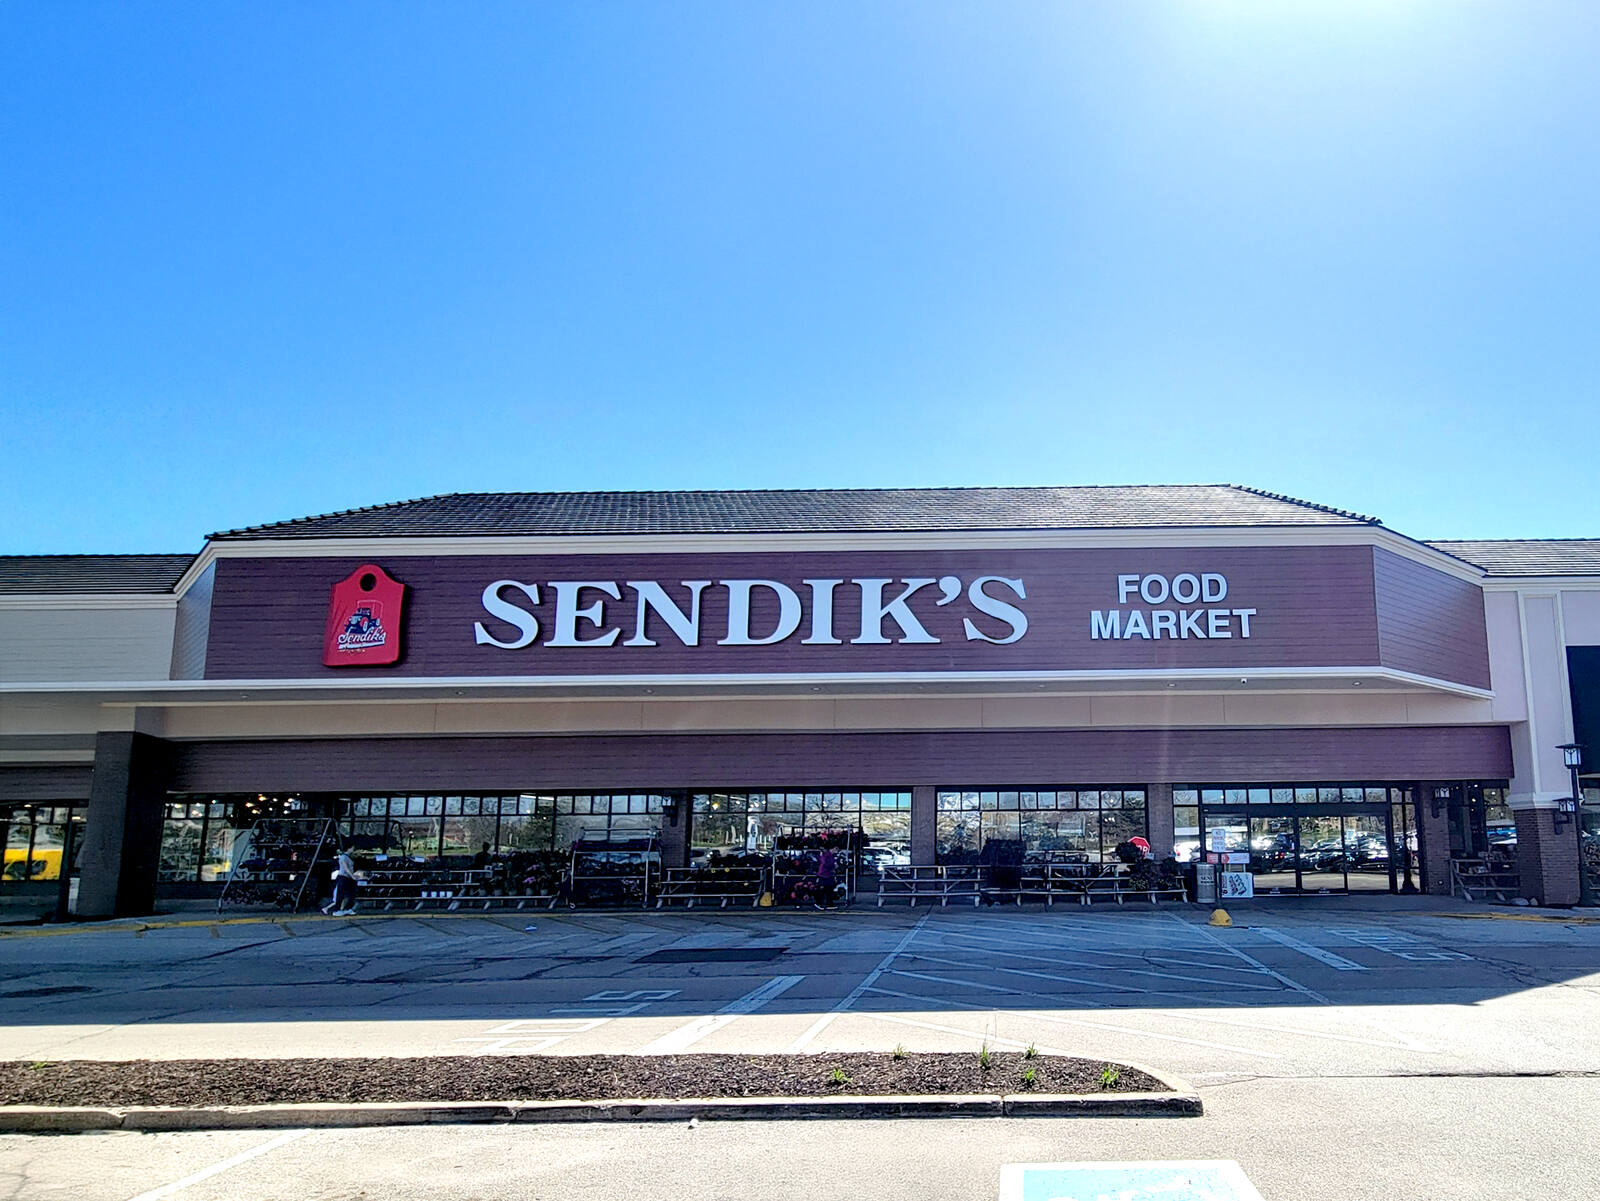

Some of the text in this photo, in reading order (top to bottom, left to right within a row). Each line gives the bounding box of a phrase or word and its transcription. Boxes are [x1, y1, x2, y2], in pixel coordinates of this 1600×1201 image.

[1118, 573, 1228, 604] FOOD
[474, 576, 1029, 649] SENDIK'S
[1090, 608, 1258, 640] MARKET
[337, 625, 386, 648] Sendik's
